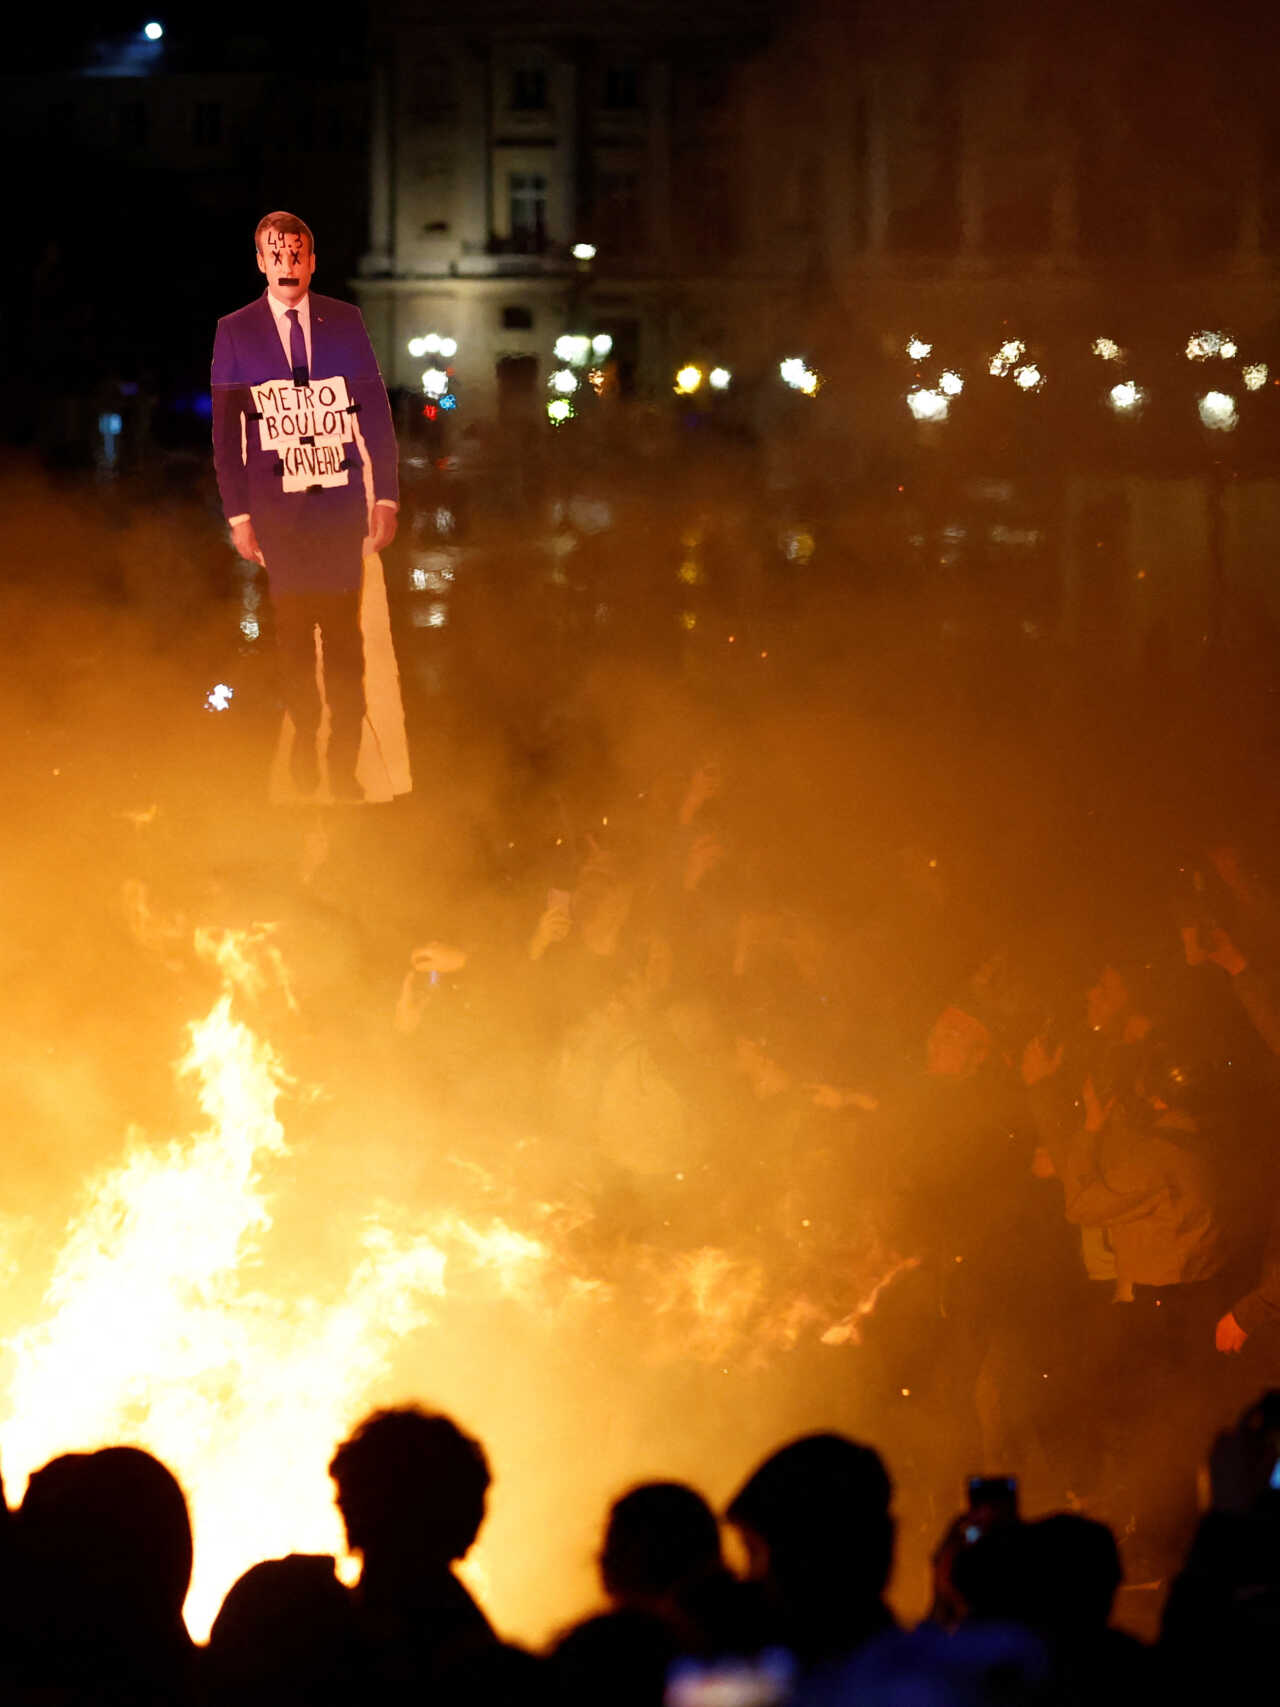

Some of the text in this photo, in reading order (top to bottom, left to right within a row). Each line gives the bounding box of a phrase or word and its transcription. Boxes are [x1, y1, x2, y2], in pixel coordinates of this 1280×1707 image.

[268, 231, 303, 249] 49.3
[257, 386, 336, 414] METRO
[266, 410, 347, 440] BOULOT
[285, 446, 342, 477] CAVEAU
